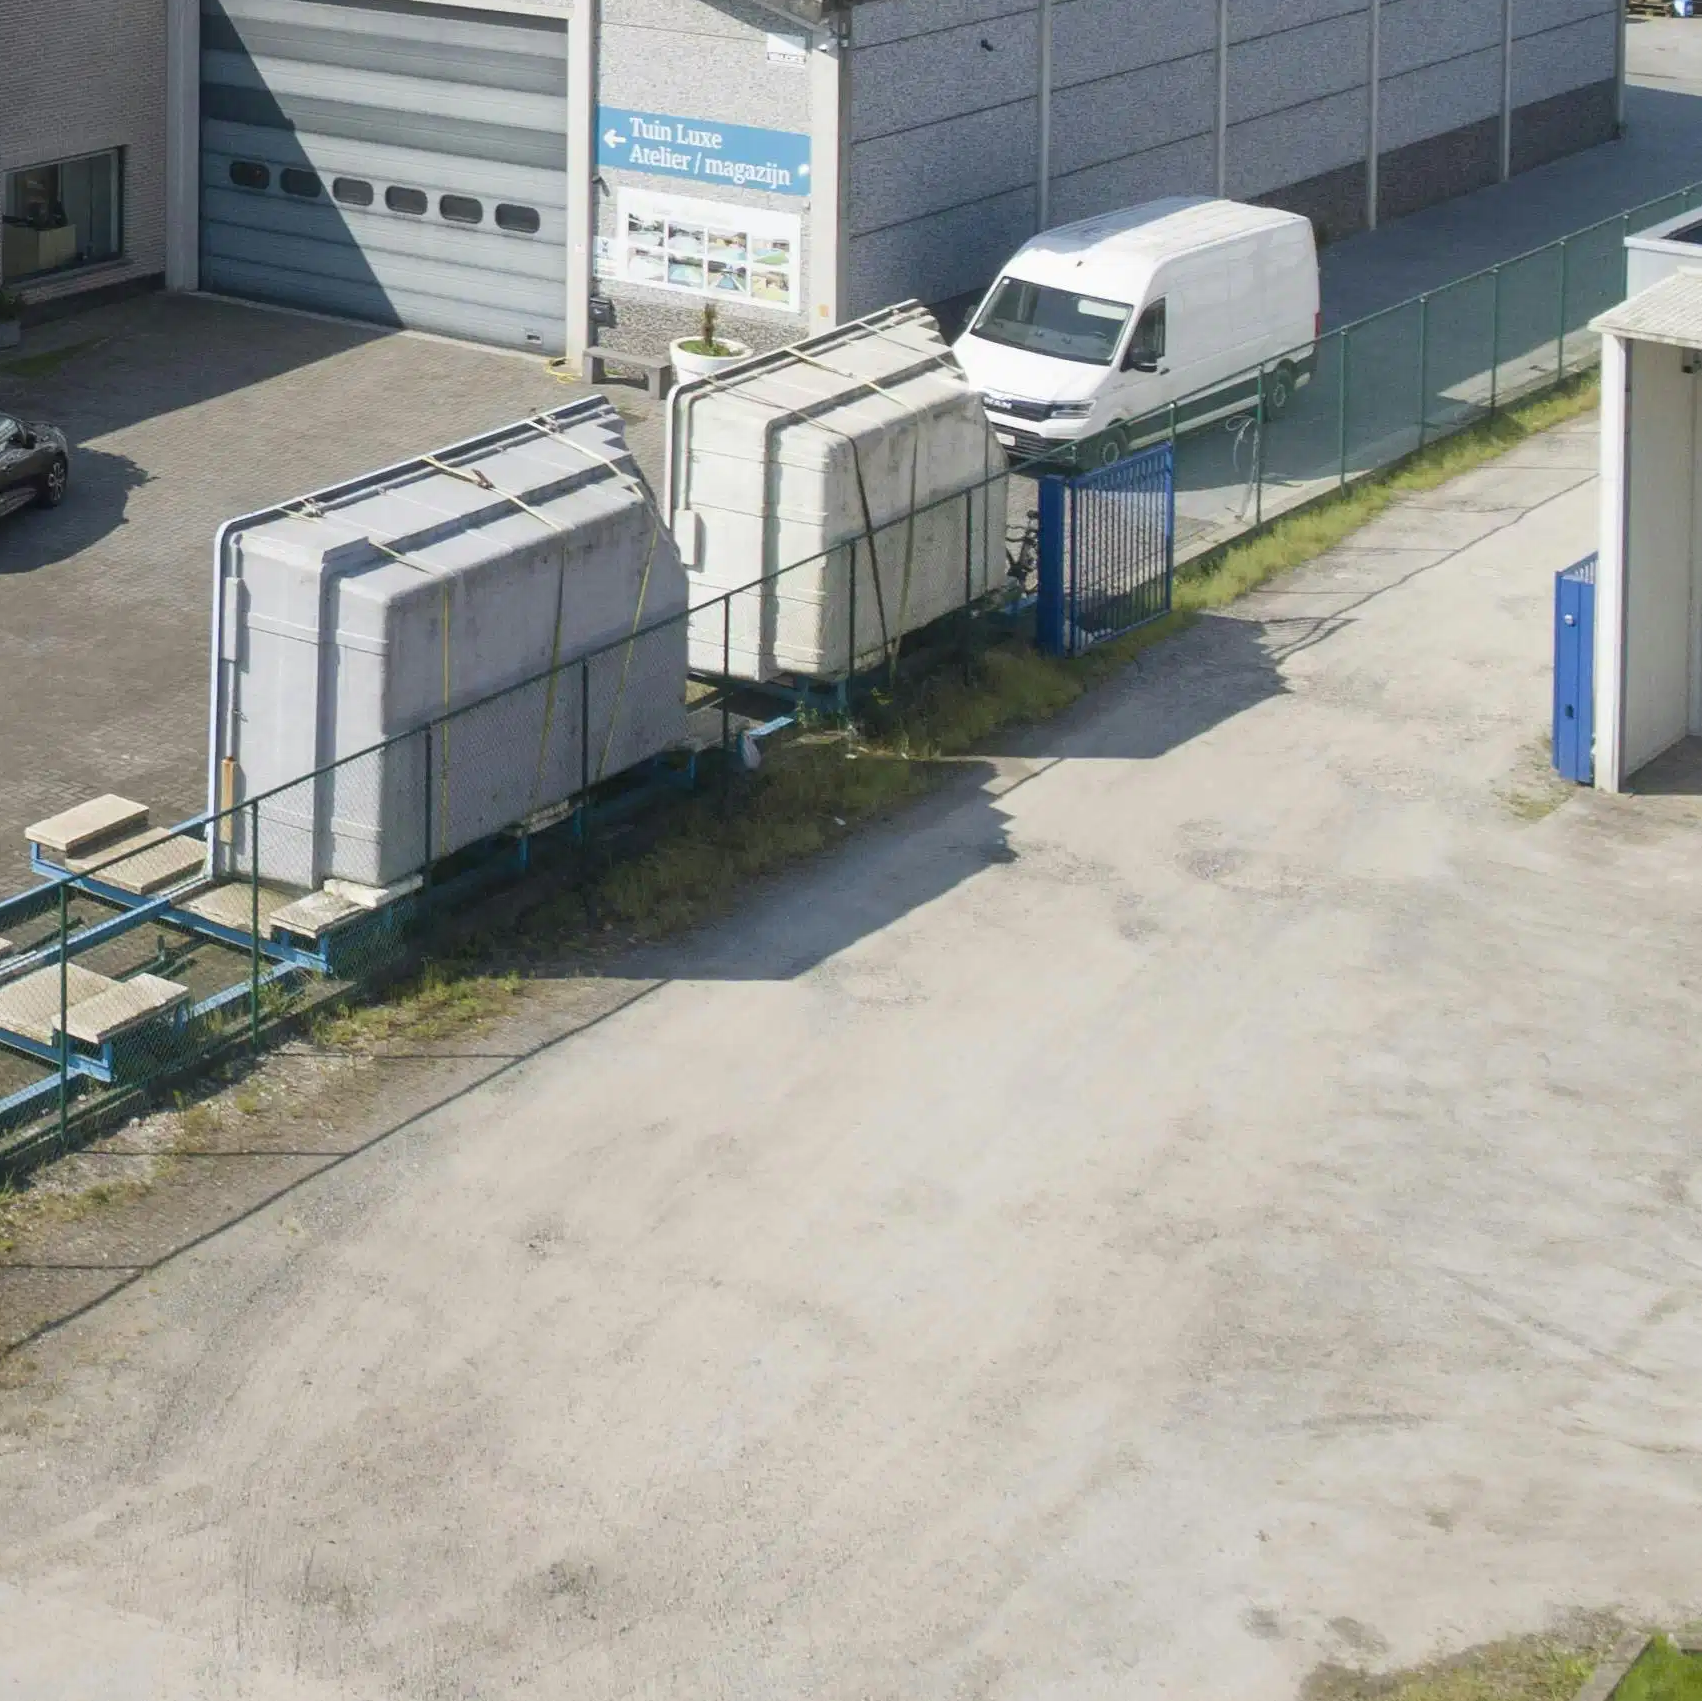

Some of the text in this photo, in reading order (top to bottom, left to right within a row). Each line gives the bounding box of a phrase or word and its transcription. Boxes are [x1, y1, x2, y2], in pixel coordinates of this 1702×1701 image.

[629, 116, 723, 150] Tuin Luxe
[629, 144, 691, 171] Atelier
[705, 157, 791, 188] magazijn
